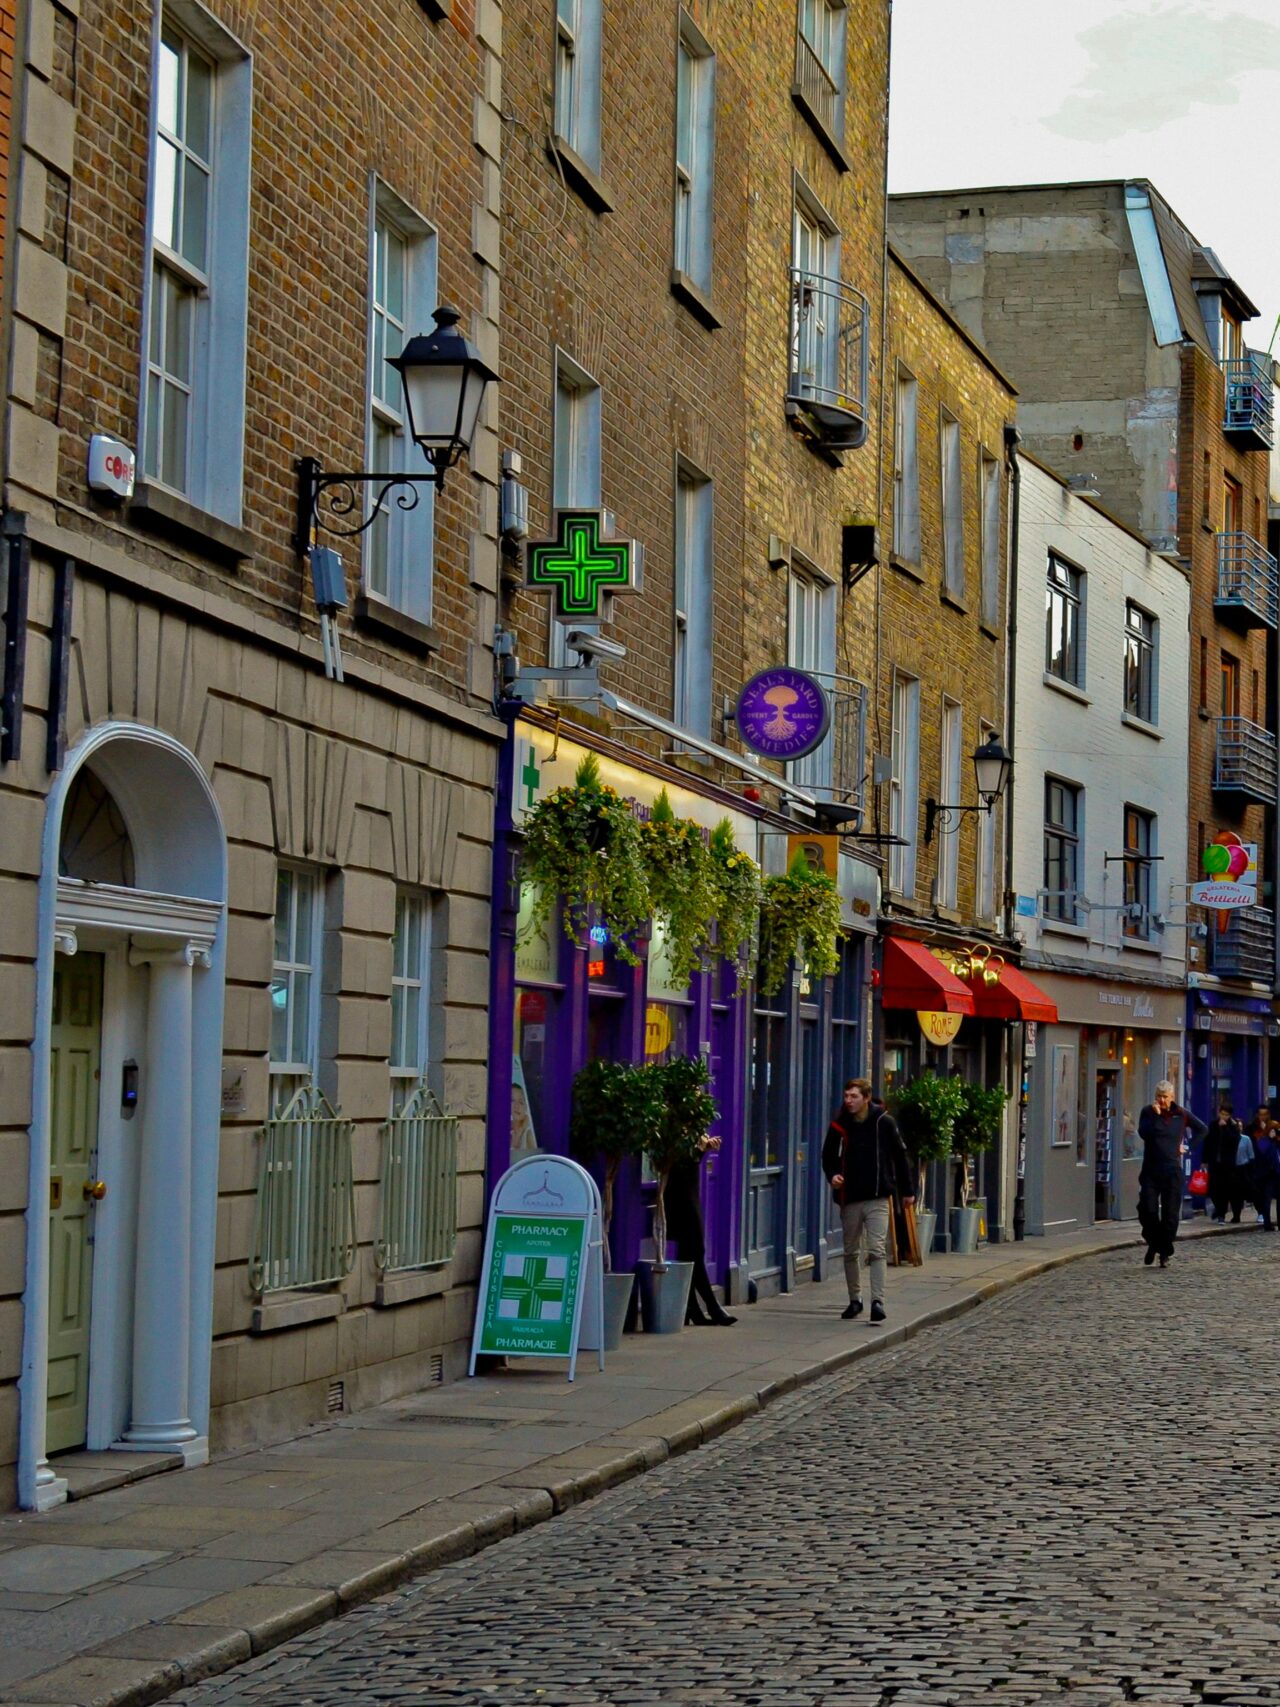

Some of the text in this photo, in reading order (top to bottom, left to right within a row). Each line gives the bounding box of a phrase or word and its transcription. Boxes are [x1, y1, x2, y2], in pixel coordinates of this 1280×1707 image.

[790, 675, 818, 709] YARD
[744, 723, 816, 752] REMEDIES
[1207, 885, 1240, 893] GELATERIA
[1197, 891, 1251, 904] Botticelli
[511, 1224, 569, 1237] PHARMACY
[564, 1249, 580, 1325] APOTHEKE
[495, 1337, 557, 1350] PHARMACIE
